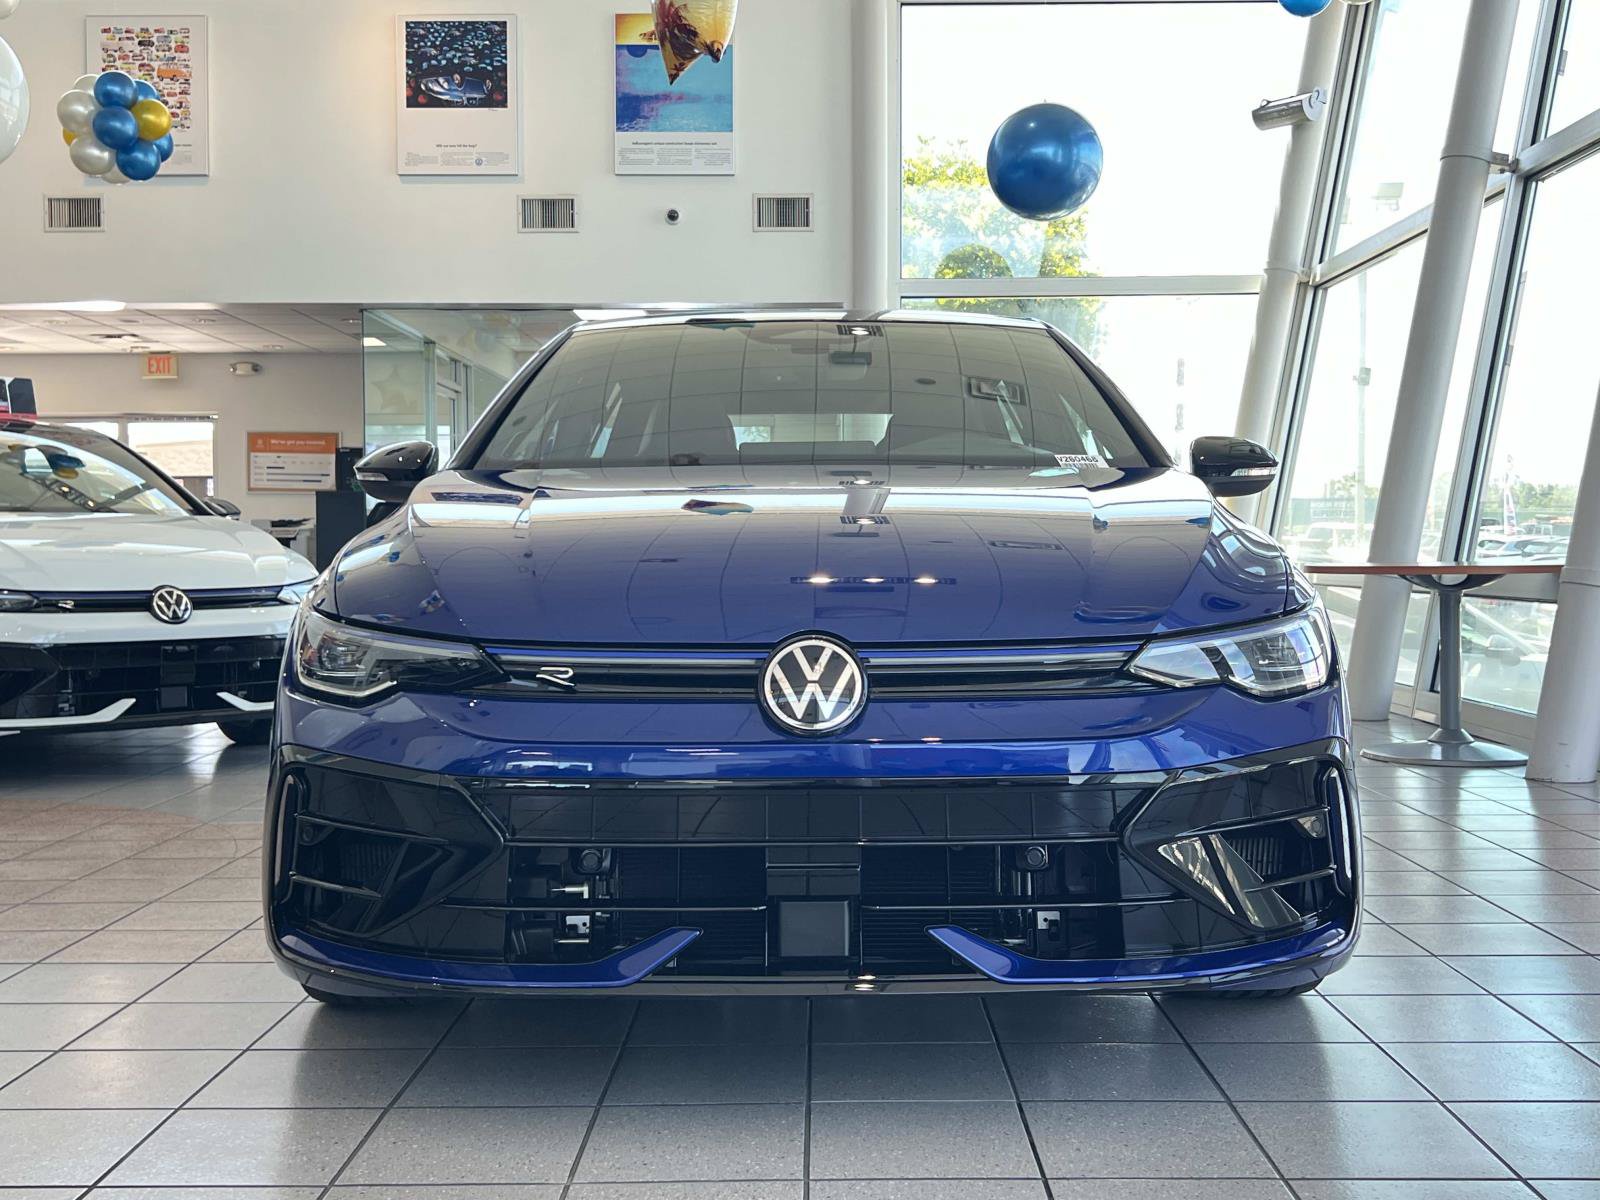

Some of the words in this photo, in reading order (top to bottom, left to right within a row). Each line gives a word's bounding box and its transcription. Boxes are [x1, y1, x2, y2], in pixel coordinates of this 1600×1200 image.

[147, 355, 171, 374] EXIT
[153, 586, 192, 622] VW
[535, 667, 575, 686] R
[764, 639, 862, 730] VW
